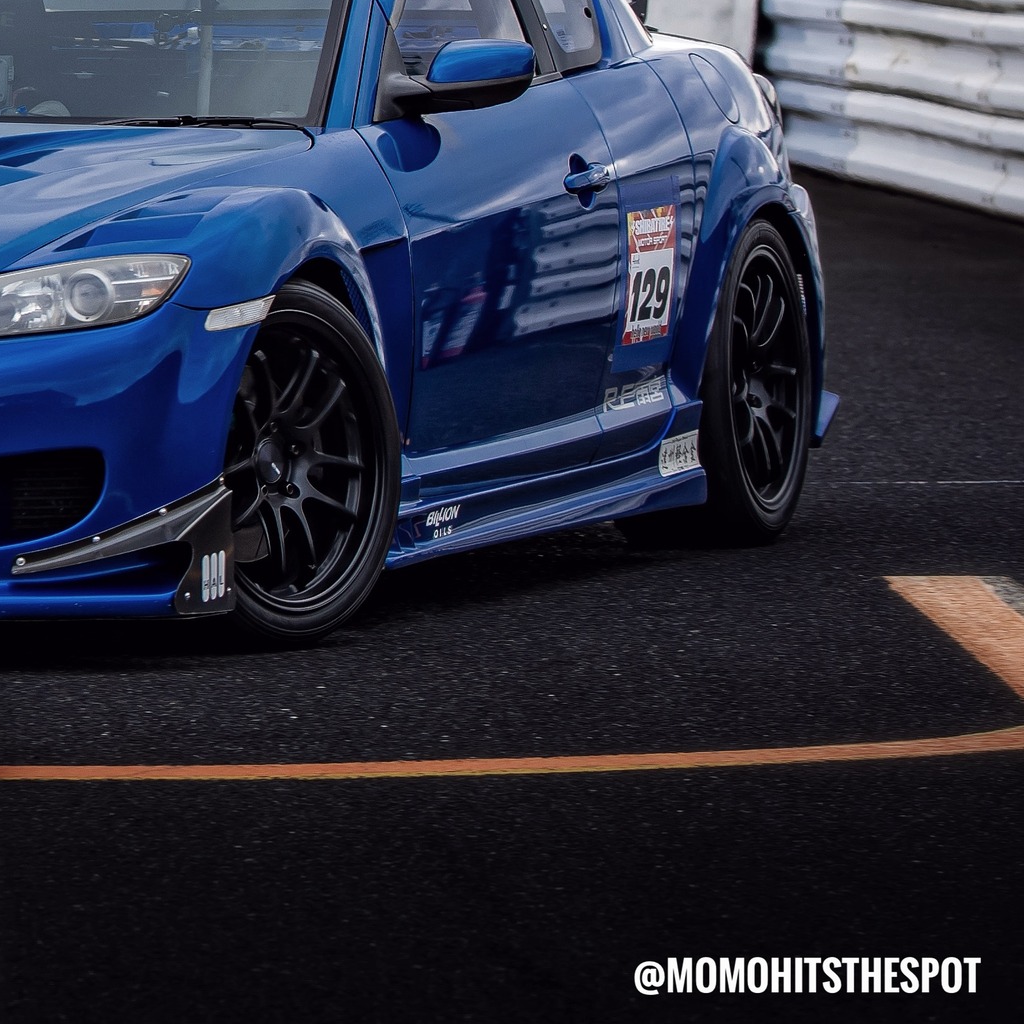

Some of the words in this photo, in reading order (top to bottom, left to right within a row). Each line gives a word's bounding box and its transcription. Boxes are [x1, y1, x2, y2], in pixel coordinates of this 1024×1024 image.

[629, 266, 671, 323] 129
[426, 504, 461, 526] BILLION
[433, 525, 452, 538] OILS
